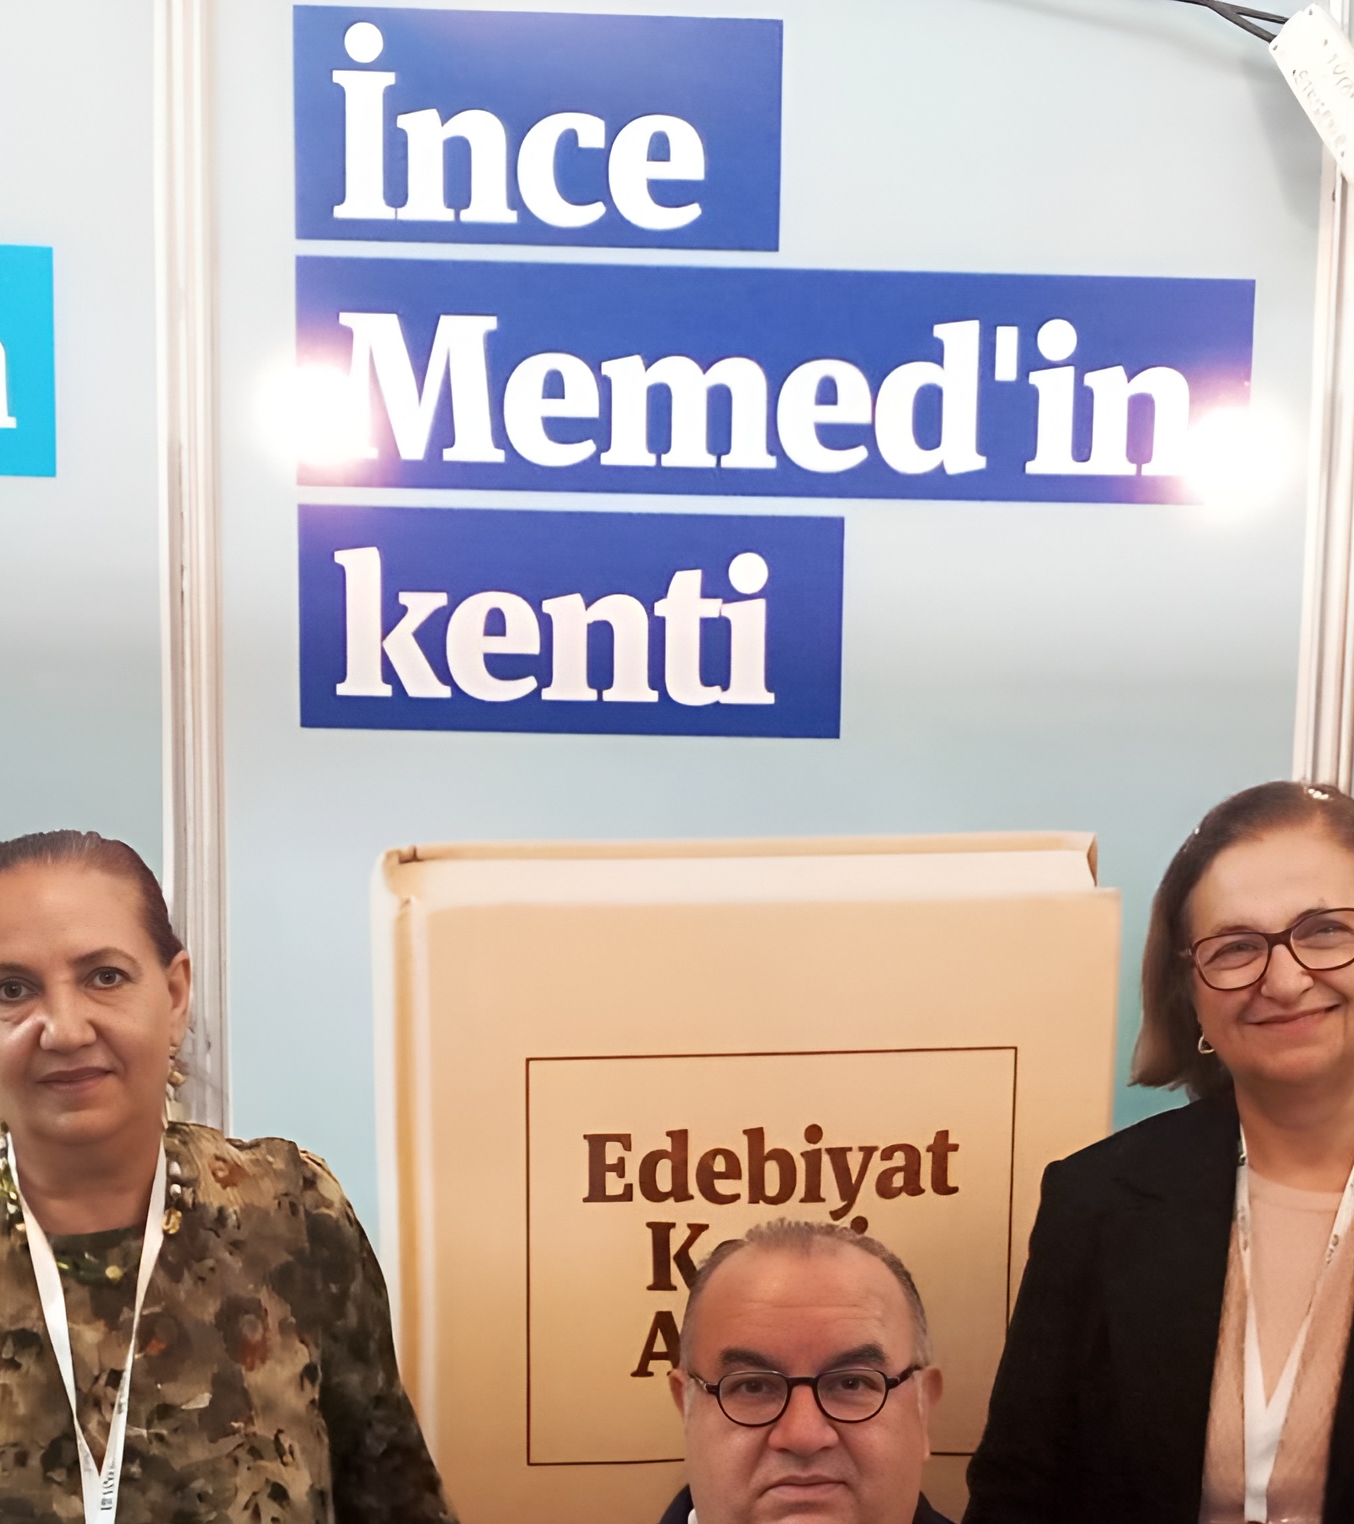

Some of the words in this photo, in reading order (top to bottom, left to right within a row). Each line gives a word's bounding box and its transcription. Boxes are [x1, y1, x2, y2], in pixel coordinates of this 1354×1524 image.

[332, 22, 705, 231] İnce
[337, 311, 1205, 477] Memed'in
[333, 546, 775, 706] kenti
[582, 1123, 960, 1221] Edebiyat
